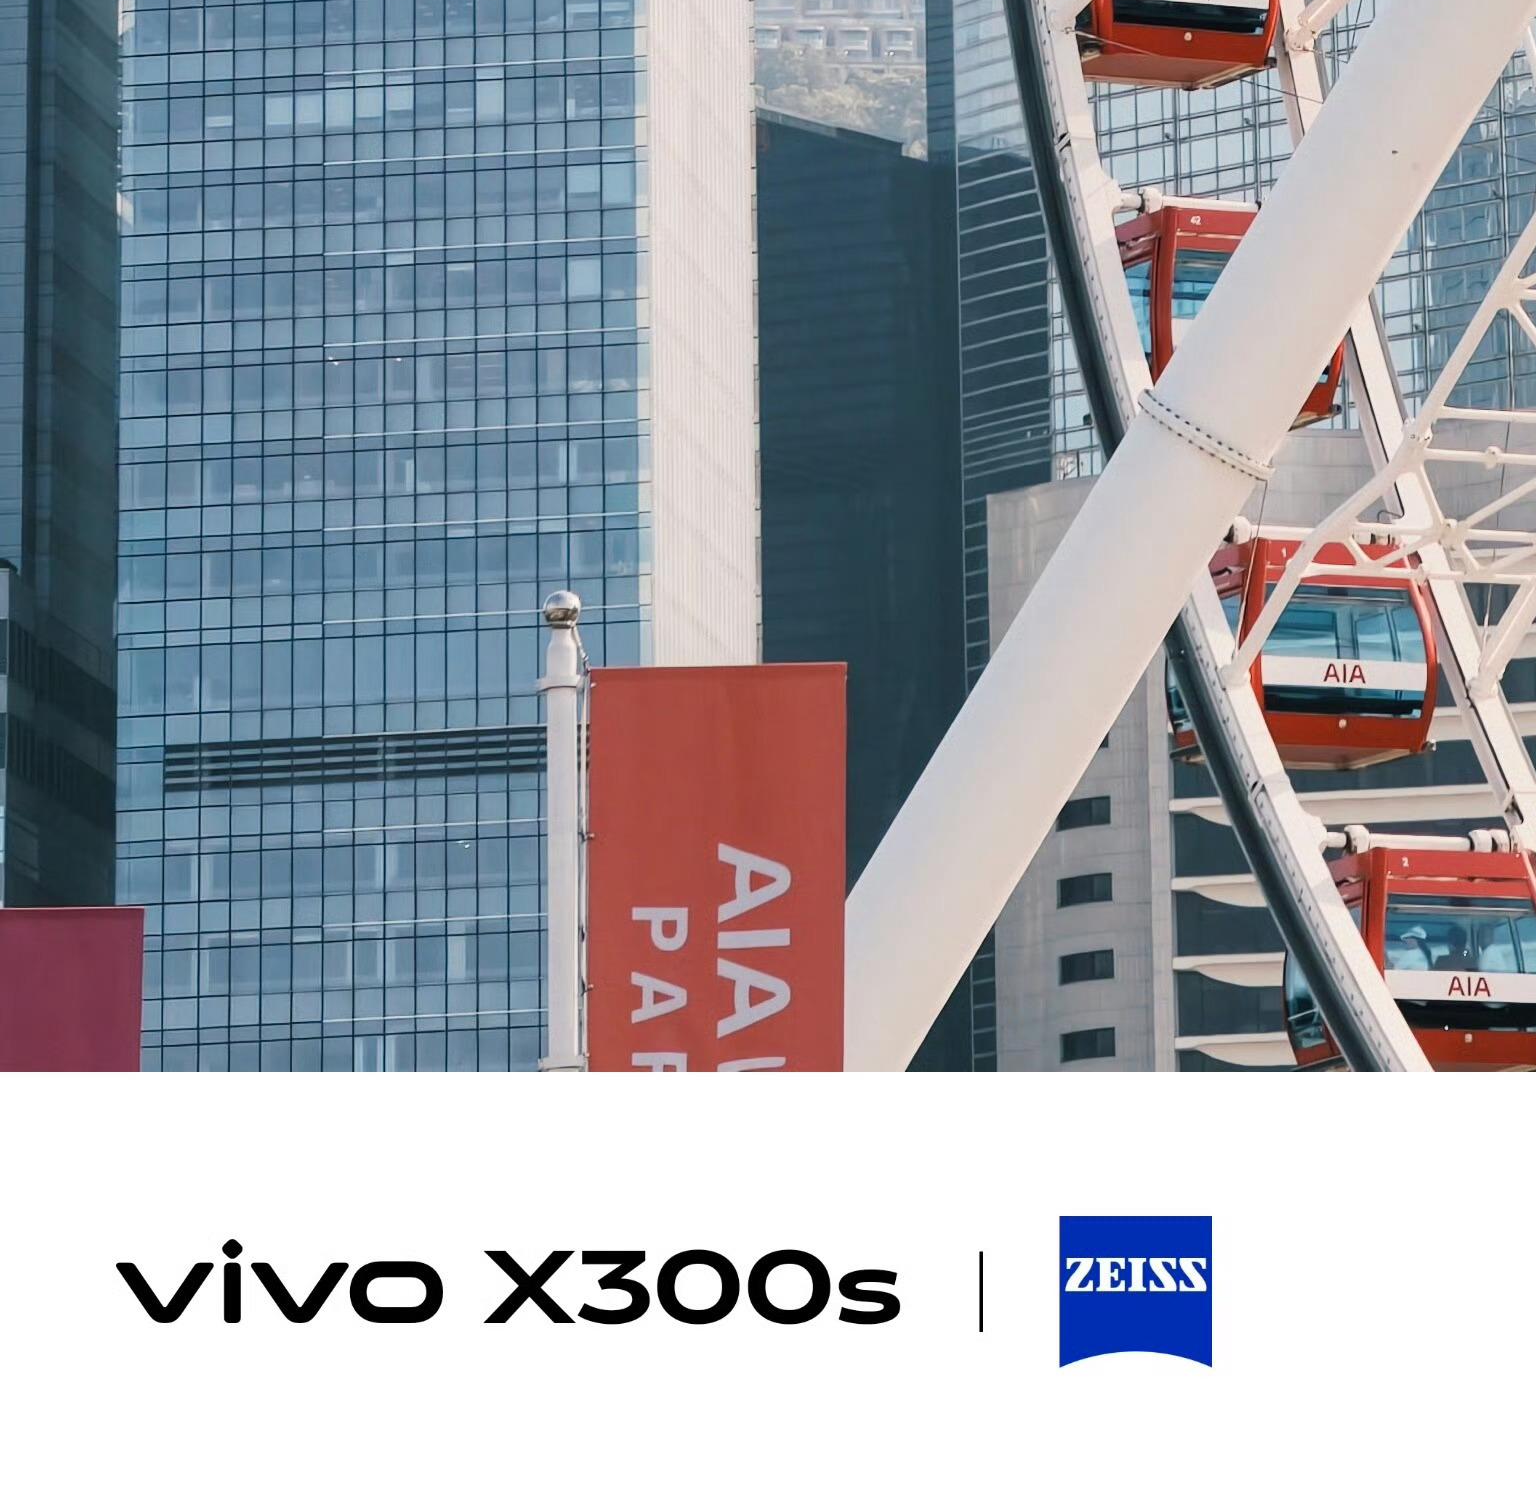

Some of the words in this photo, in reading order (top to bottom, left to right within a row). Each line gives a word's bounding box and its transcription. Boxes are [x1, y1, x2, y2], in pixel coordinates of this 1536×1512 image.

[1322, 663, 1366, 684] AIA
[716, 842, 792, 1039] AIA
[1447, 975, 1491, 997] AIA
